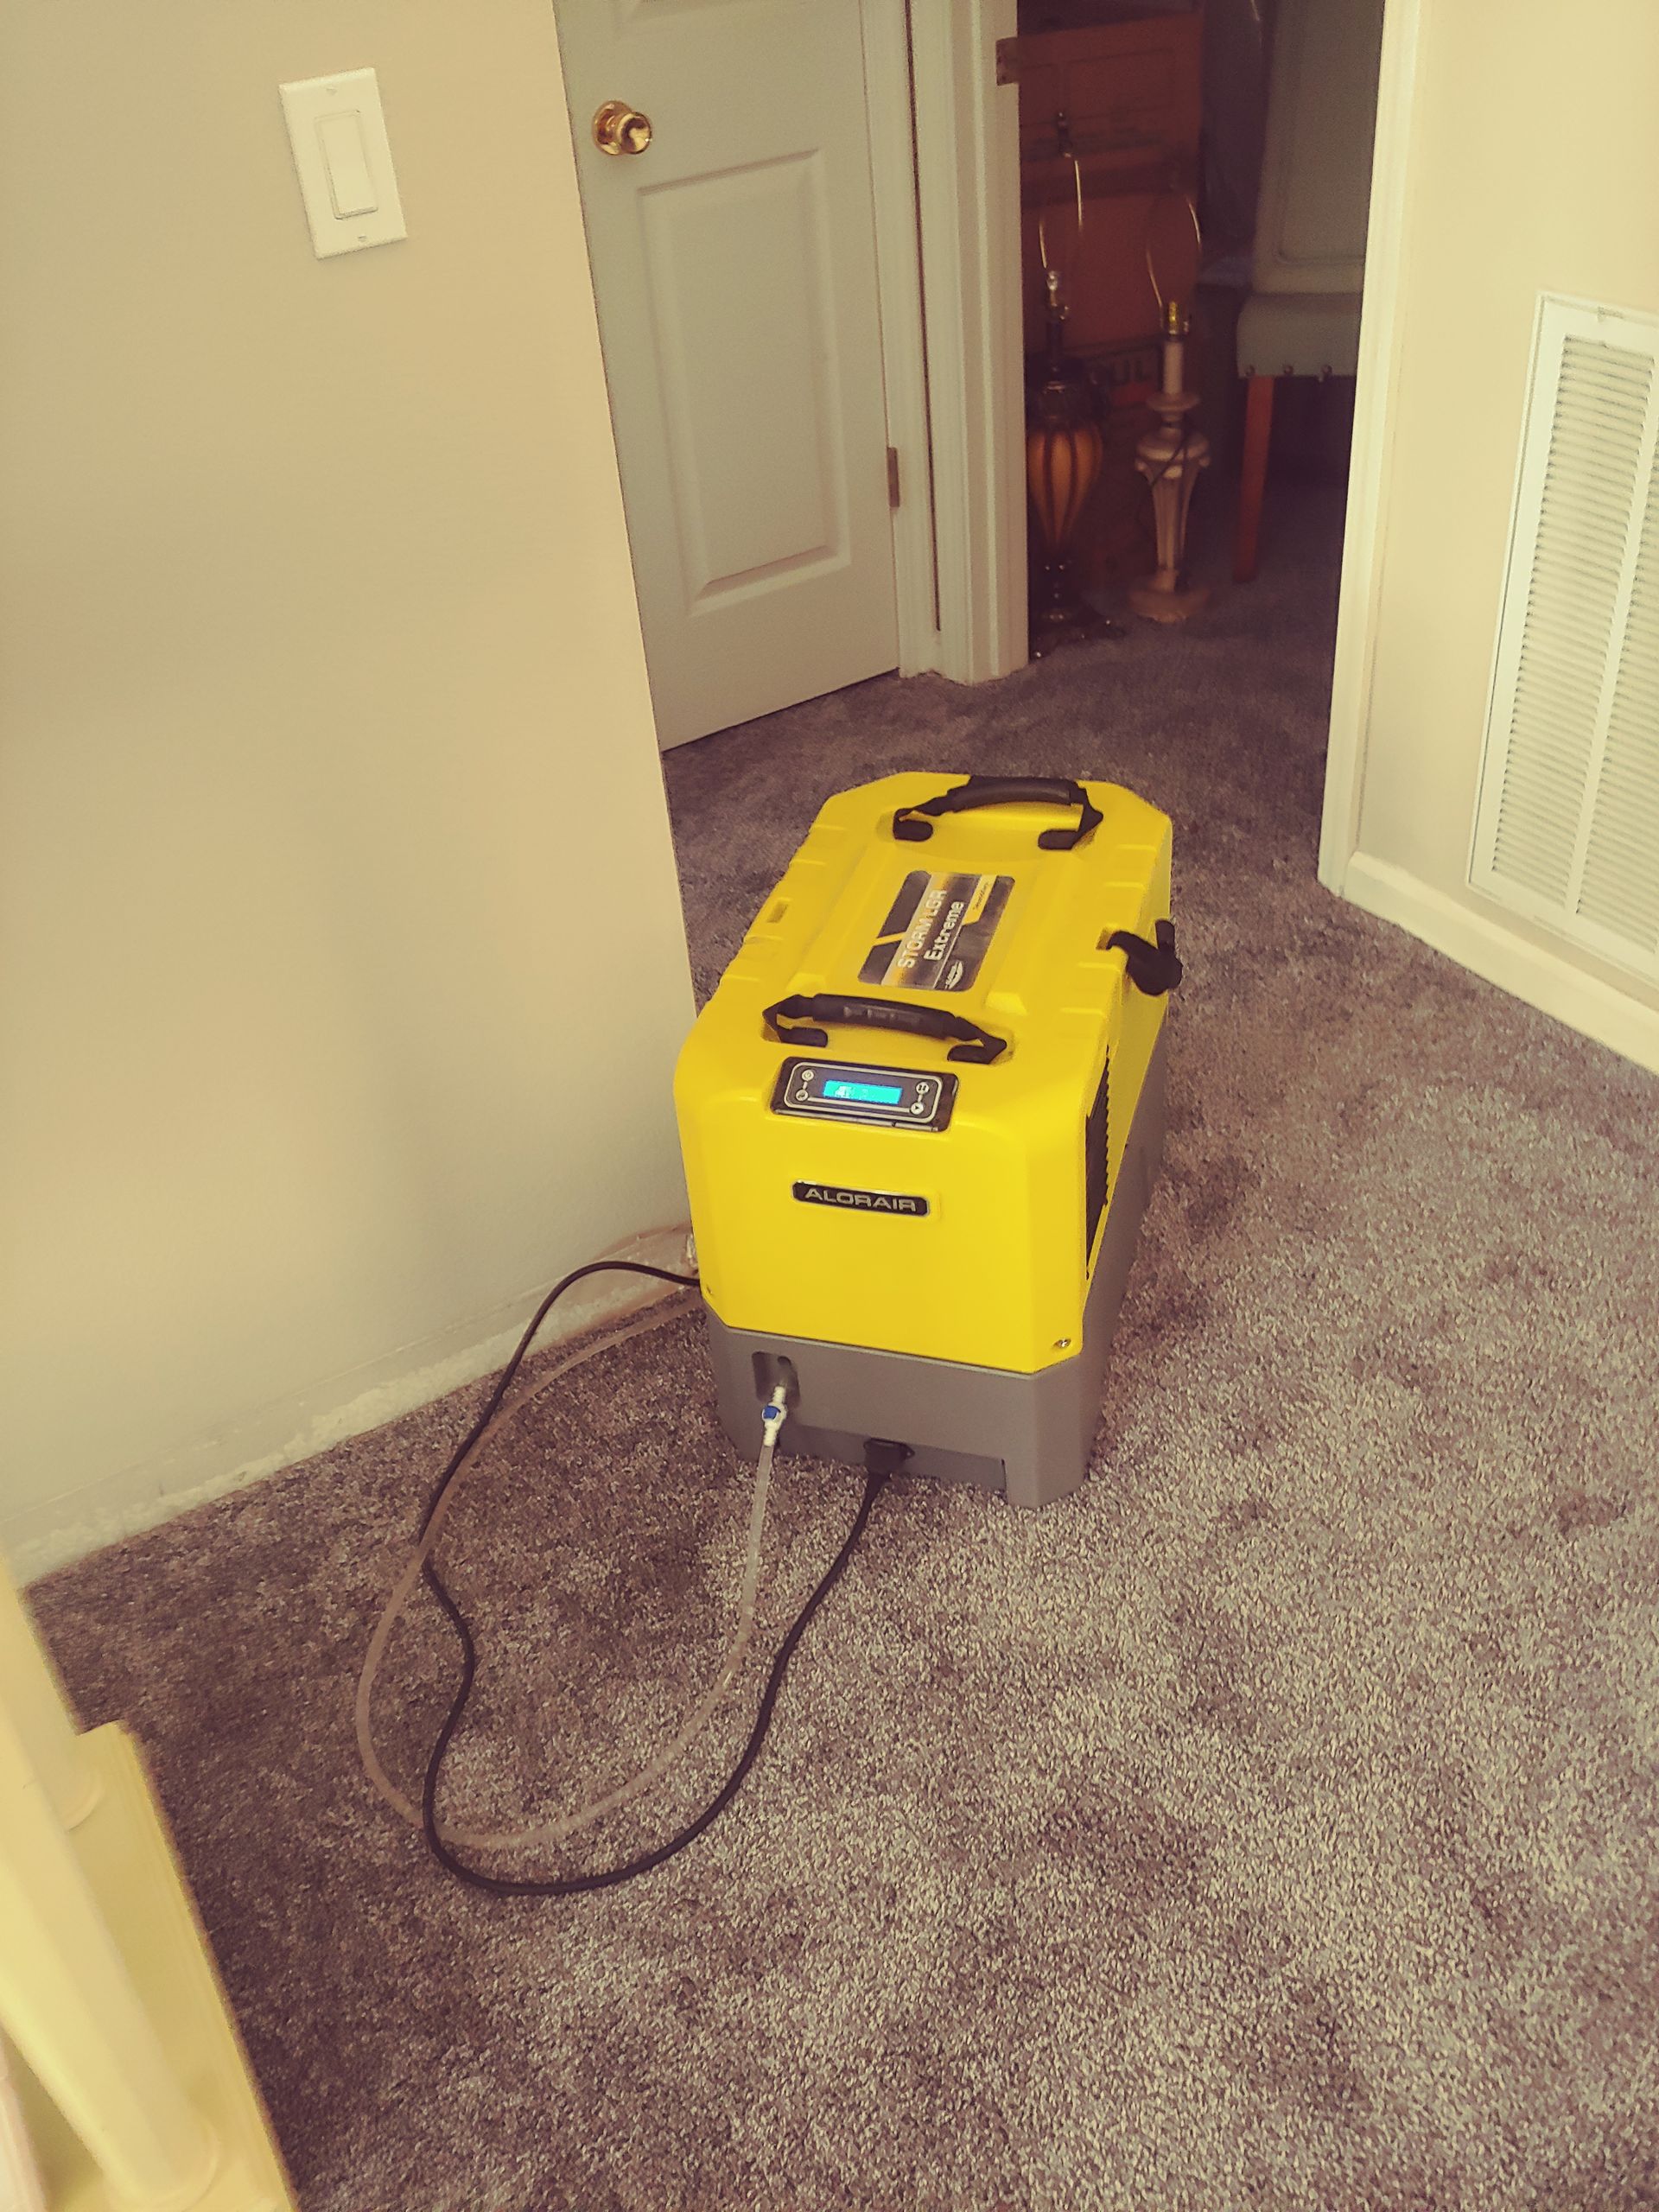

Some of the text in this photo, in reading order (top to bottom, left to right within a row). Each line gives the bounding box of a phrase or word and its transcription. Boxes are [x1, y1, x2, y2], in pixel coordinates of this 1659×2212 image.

[898, 889, 948, 969] STORM LGR
[923, 900, 965, 961] Extreme
[804, 1188, 917, 1211] ALORAIR
